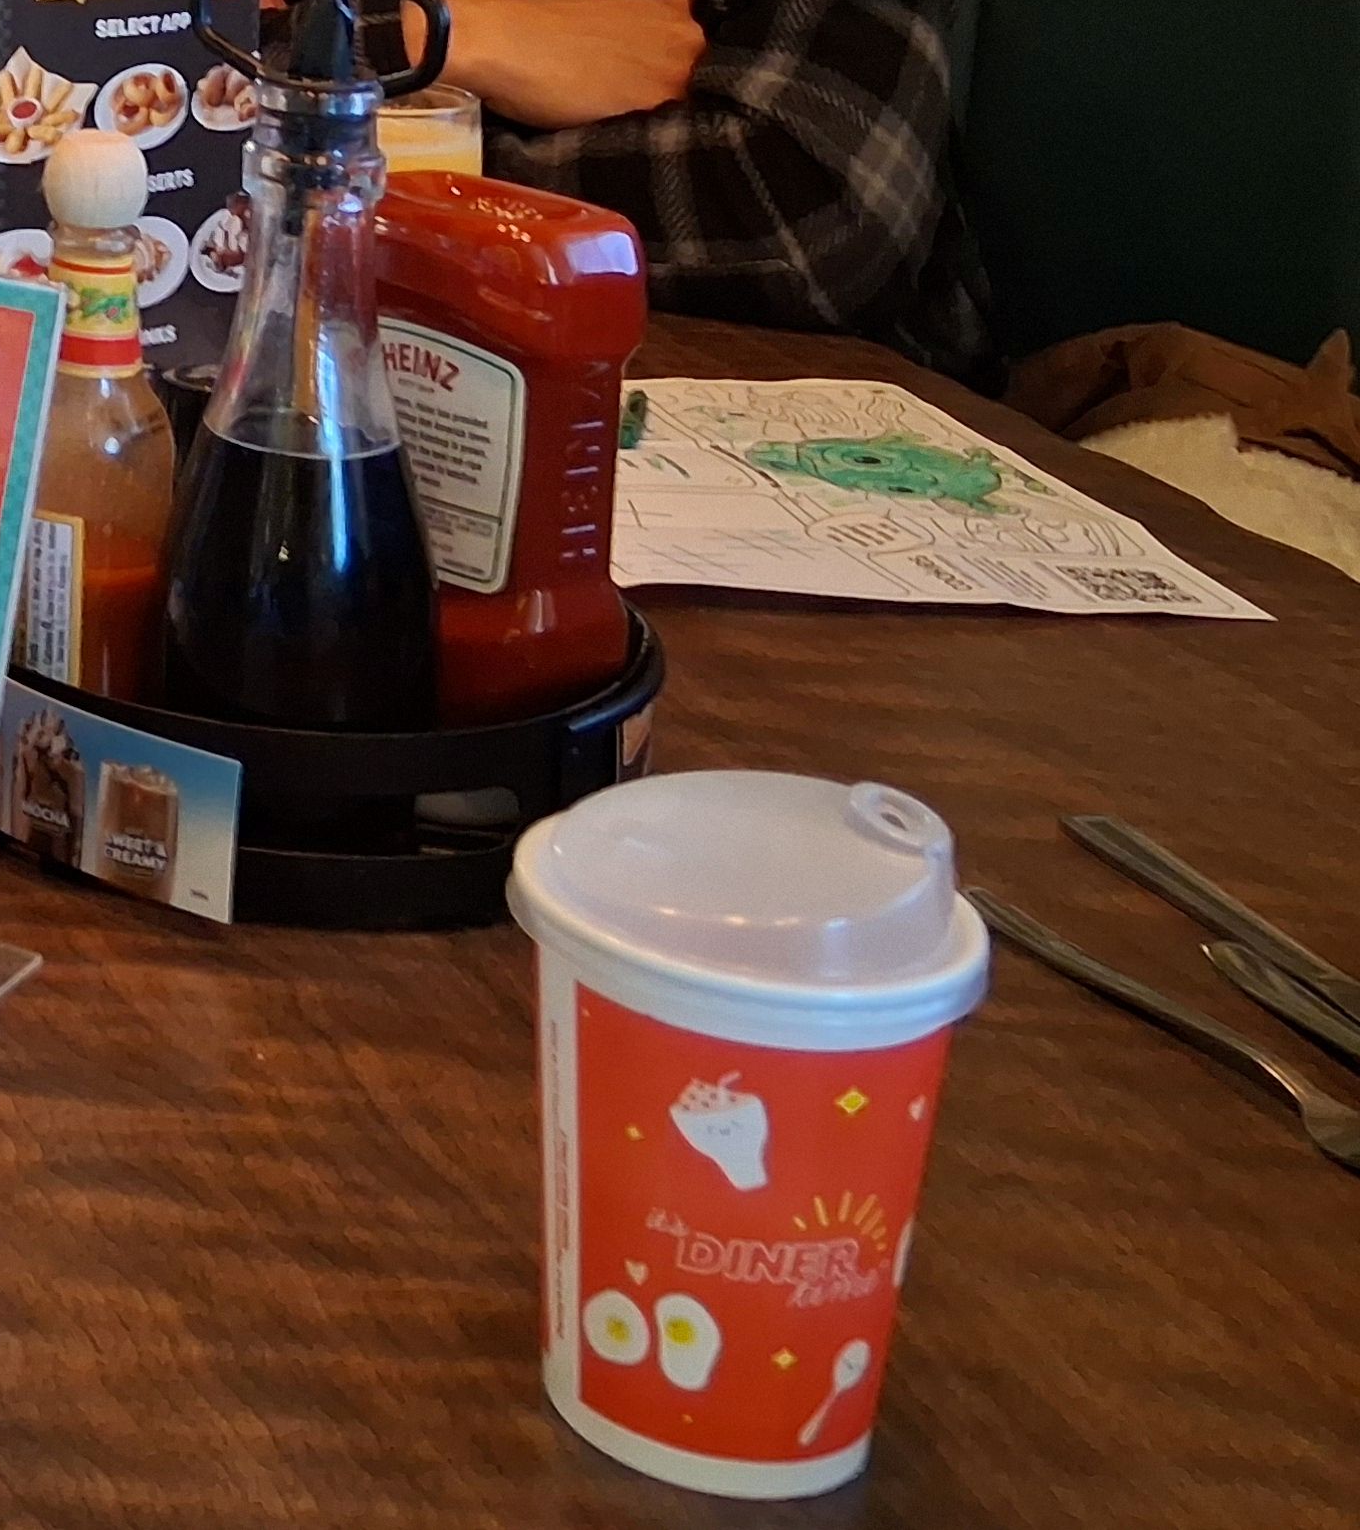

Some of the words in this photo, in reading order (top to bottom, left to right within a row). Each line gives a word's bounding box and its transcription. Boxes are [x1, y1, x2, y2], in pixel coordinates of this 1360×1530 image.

[94, 17, 161, 39] SELECT
[147, 168, 195, 193] SERTS
[383, 342, 460, 392] HEINZ
[677, 1232, 859, 1286] DINER
